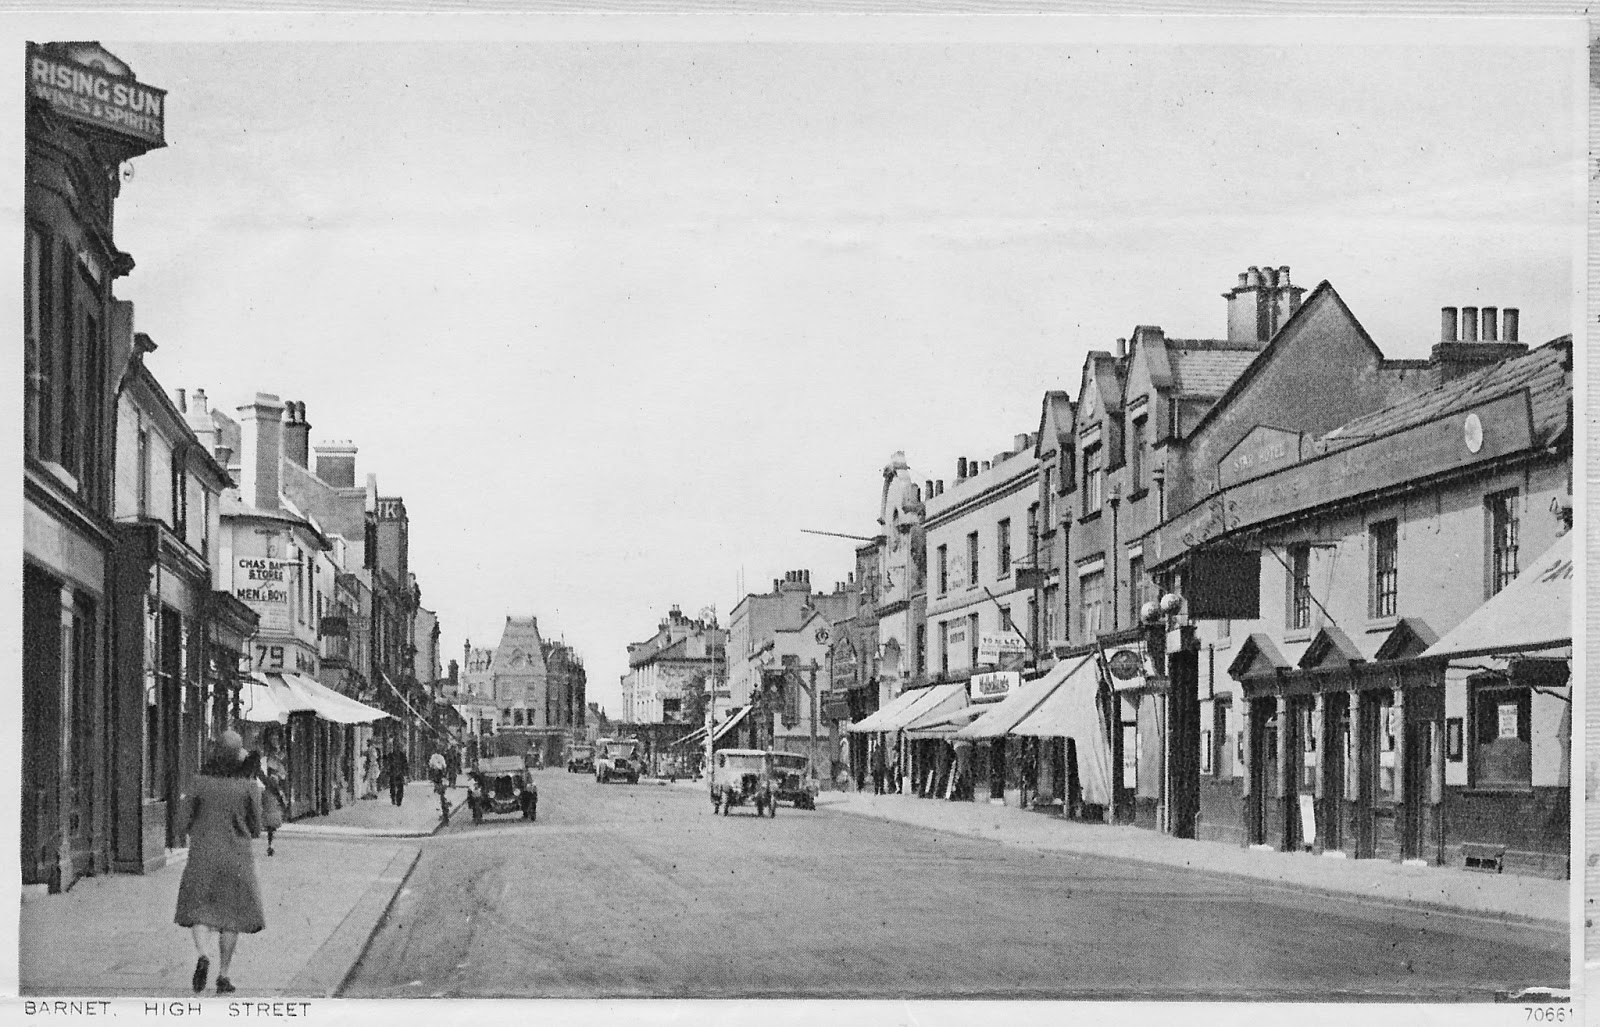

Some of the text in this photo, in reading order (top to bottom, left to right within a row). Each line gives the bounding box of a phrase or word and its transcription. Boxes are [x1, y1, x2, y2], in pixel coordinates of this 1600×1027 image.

[32, 57, 161, 117] RISING SUN
[104, 106, 161, 135] SPIRITS
[239, 560, 266, 569] CHAS
[249, 570, 283, 581] STORES
[237, 588, 260, 600] MEN
[255, 645, 284, 669] 79
